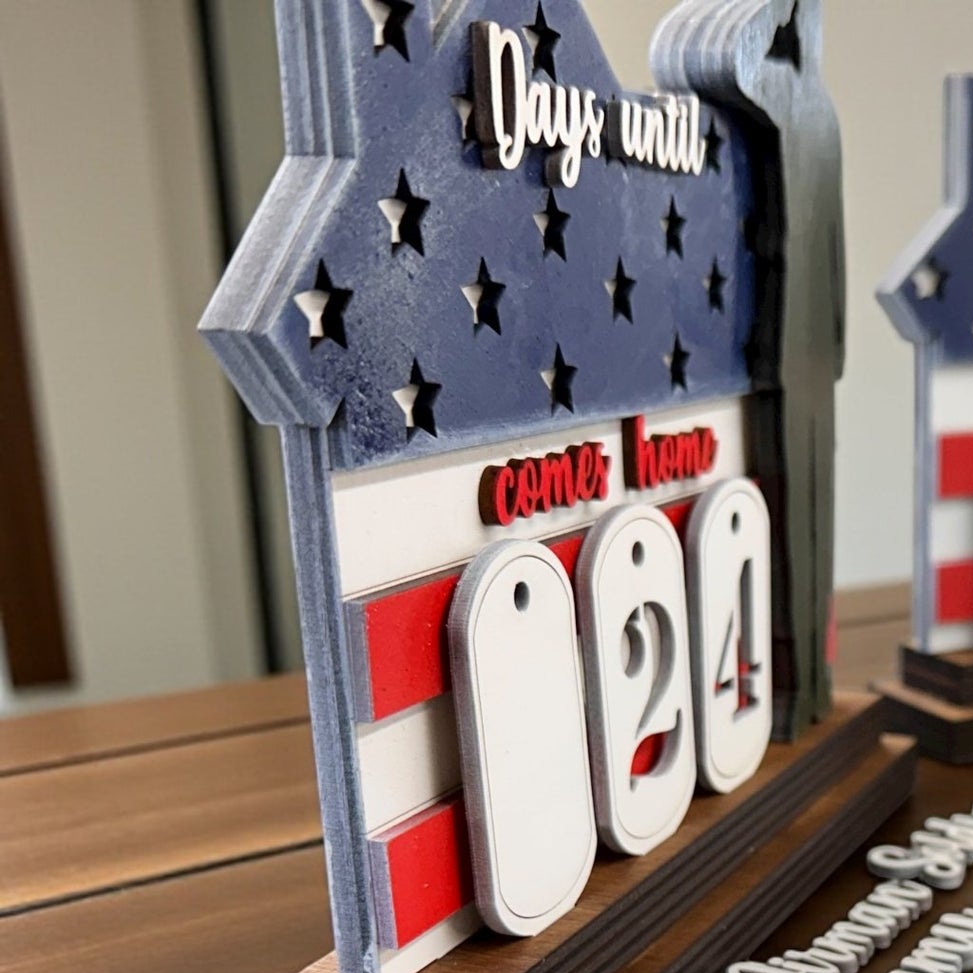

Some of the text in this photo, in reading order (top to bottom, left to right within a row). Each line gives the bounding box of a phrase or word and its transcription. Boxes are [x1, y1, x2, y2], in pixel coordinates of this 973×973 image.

[478, 21, 706, 188] Days until
[484, 414, 718, 527] comes home
